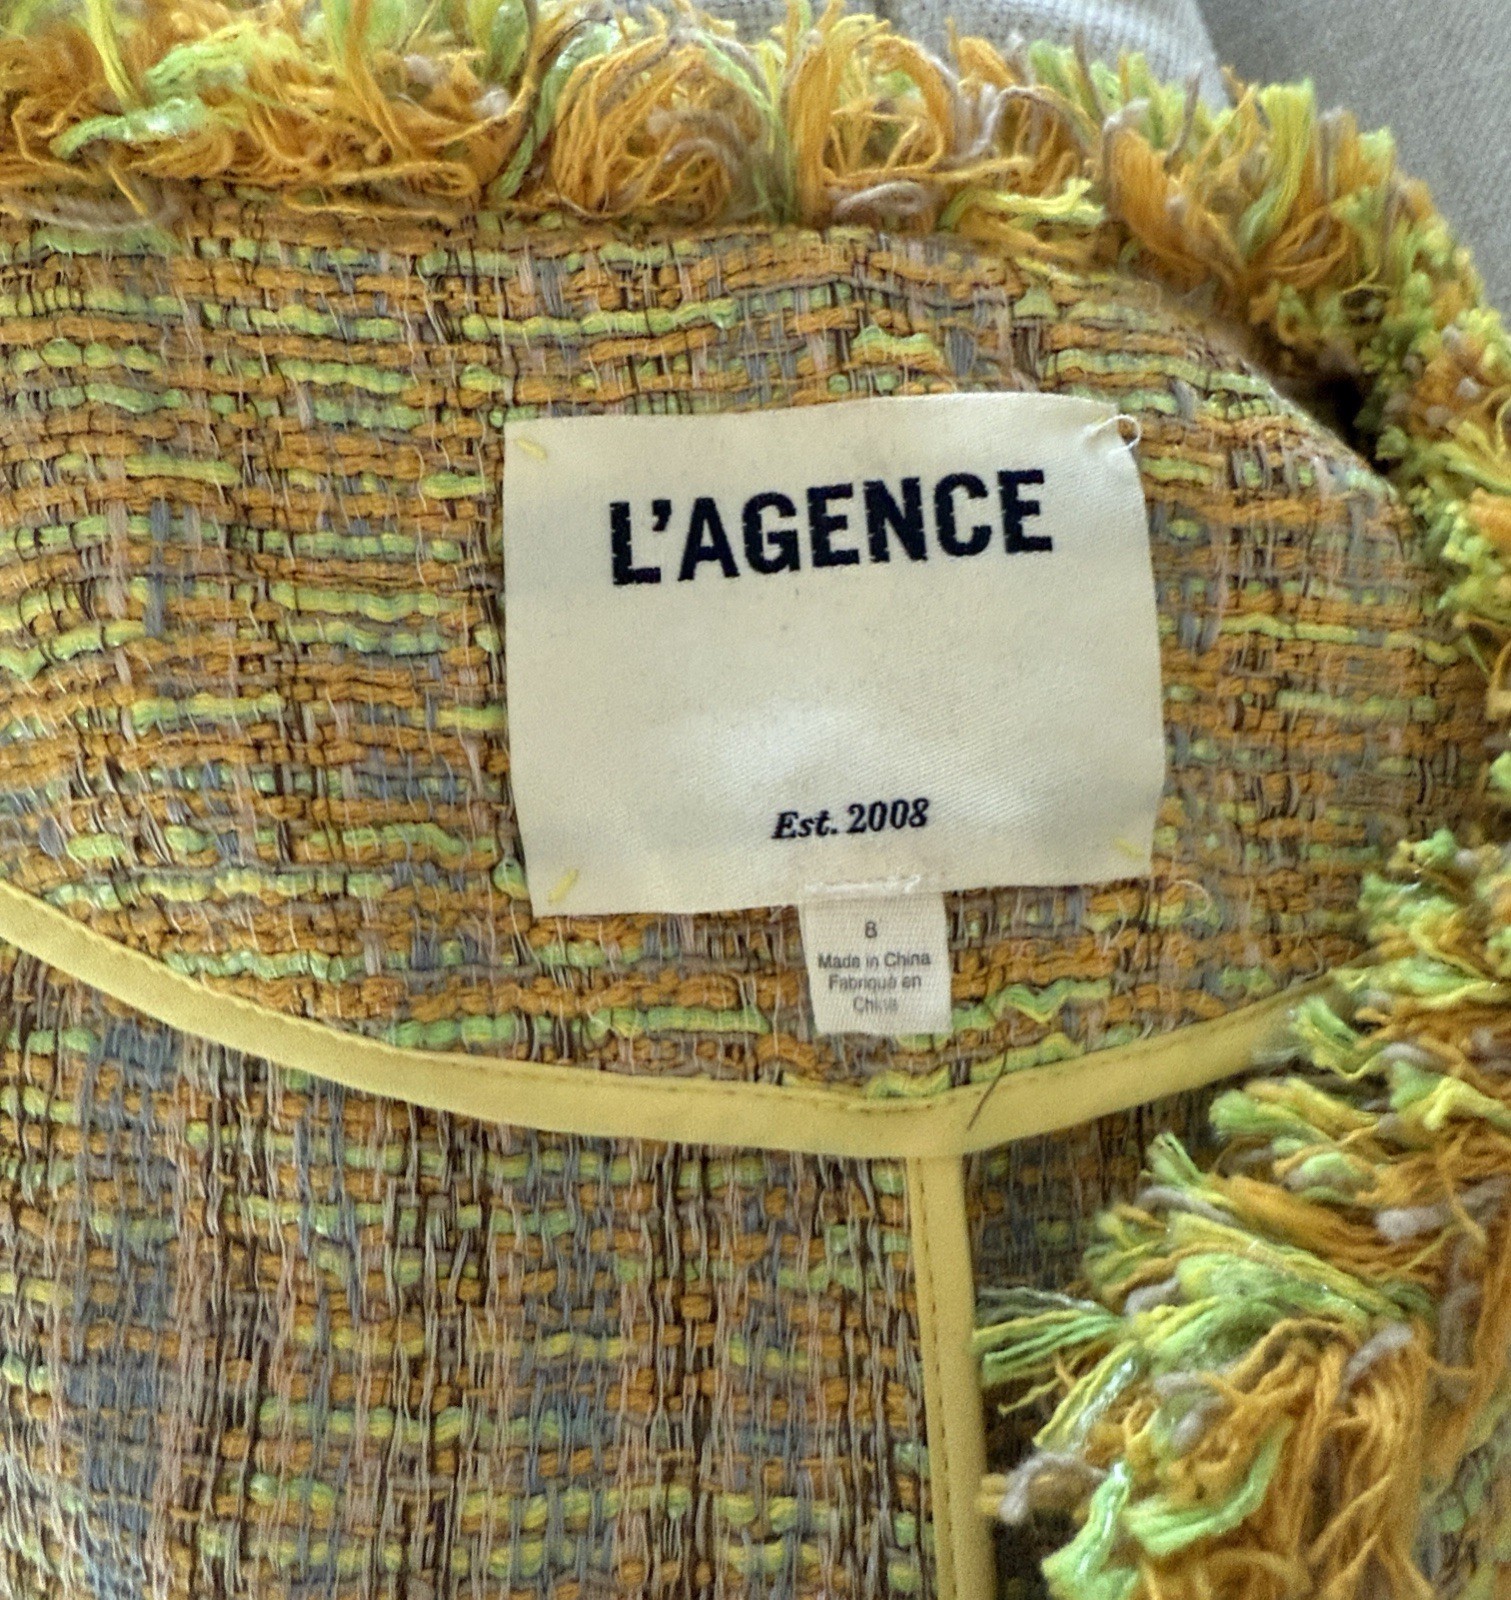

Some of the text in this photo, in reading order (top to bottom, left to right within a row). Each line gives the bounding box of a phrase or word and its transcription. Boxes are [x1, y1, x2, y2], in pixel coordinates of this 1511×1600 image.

[610, 469, 1053, 585] L’AGENCE
[771, 797, 929, 839] Est. 2008
[864, 921, 878, 938] 8
[818, 951, 931, 969] Made in China
[902, 974, 922, 989] en
